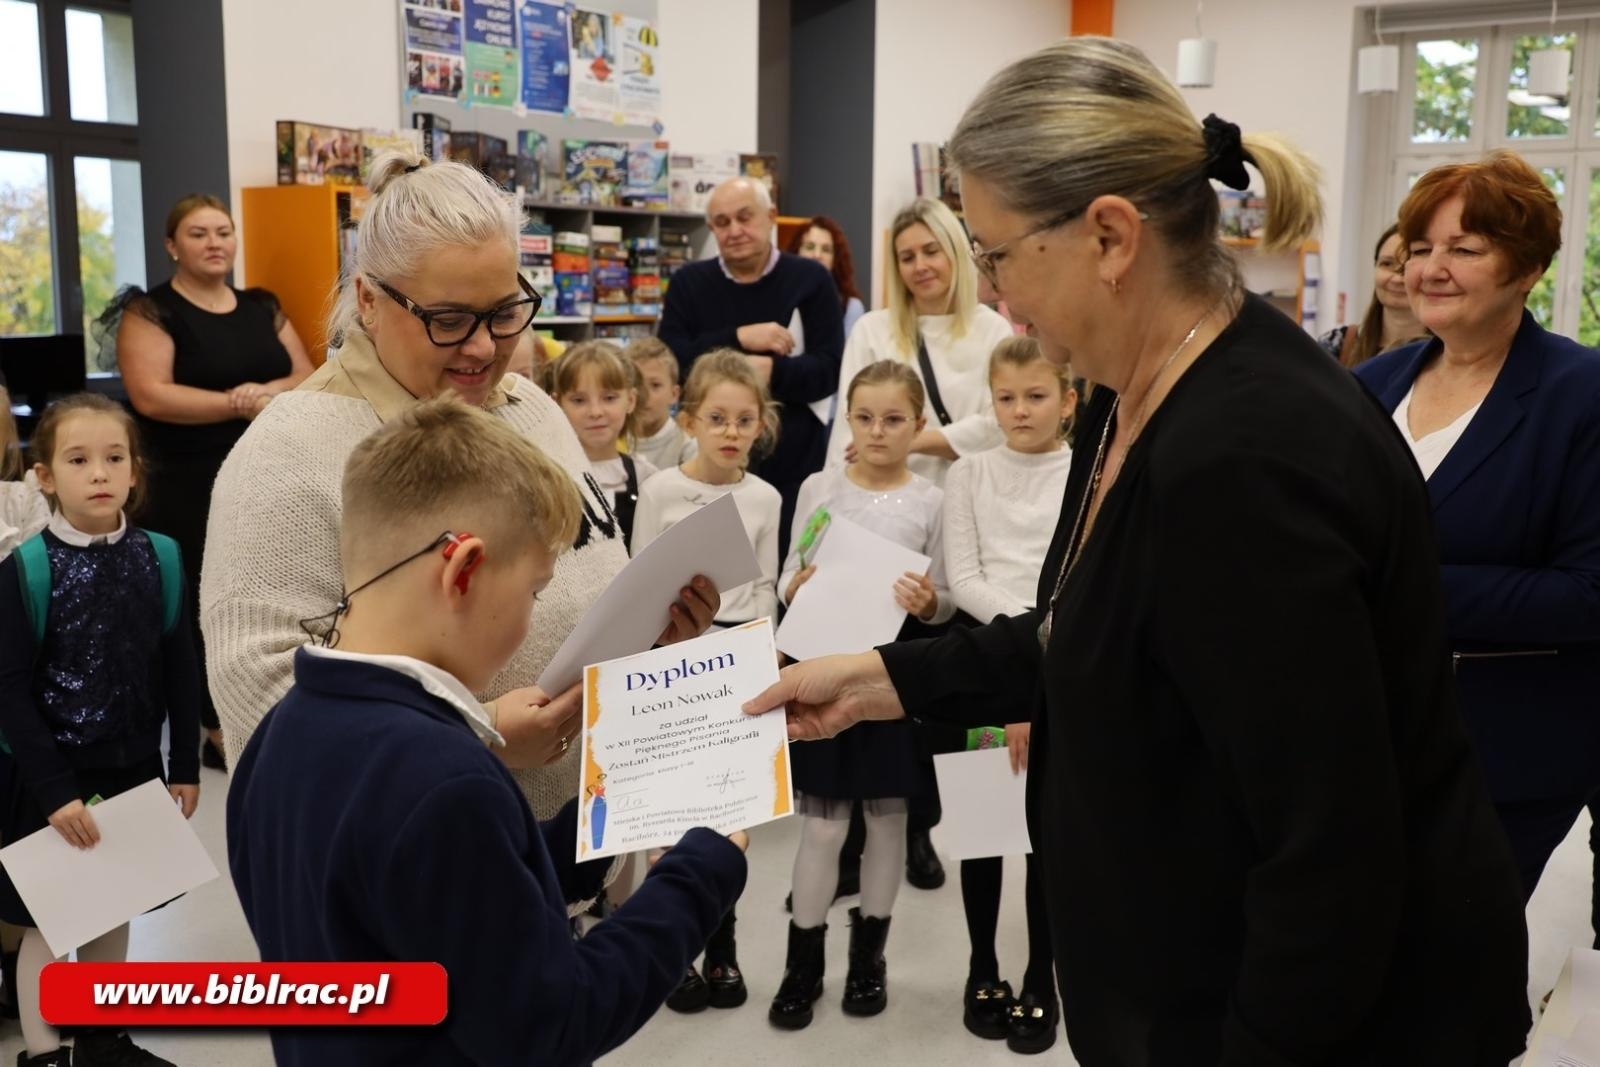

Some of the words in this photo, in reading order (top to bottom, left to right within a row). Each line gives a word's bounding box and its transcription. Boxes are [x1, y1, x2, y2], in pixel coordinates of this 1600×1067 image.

[626, 653, 735, 691] Dyplom
[632, 700, 673, 716] Leon
[678, 684, 734, 707] Nowak
[659, 721, 672, 730] za
[675, 714, 708, 727] udział
[605, 742, 616, 750] w
[618, 738, 631, 748] XII
[633, 725, 705, 745] Powiatowym
[608, 756, 649, 771] Zostań
[651, 744, 705, 762] Mistrzem
[709, 730, 760, 748] Kaligrafii
[635, 738, 687, 755] Pięknego
[689, 729, 730, 743] Pisania
